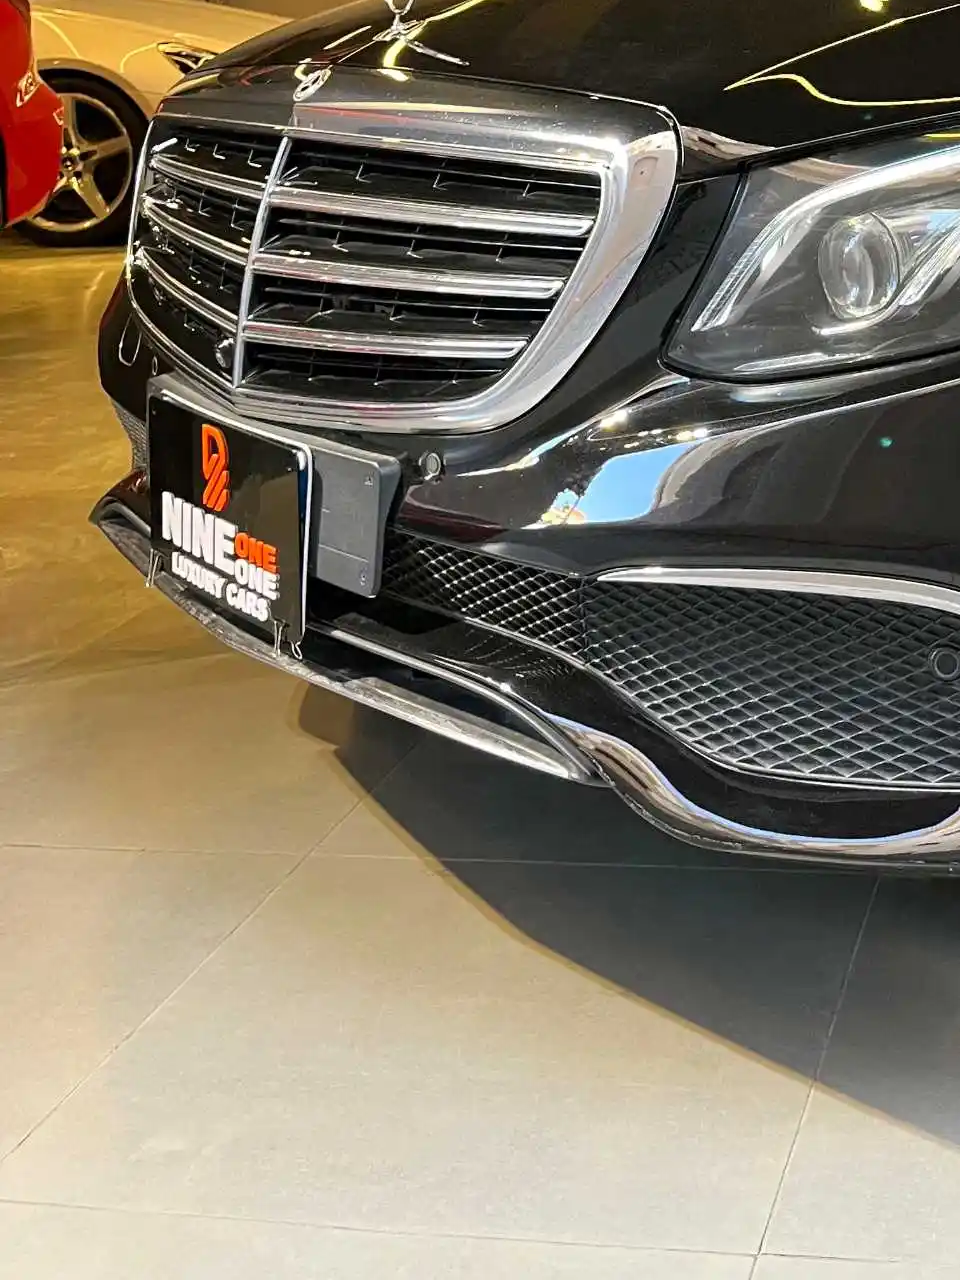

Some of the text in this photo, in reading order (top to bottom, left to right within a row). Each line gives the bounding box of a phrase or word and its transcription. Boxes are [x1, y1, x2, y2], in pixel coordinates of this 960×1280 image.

[161, 490, 240, 576] NINE
[235, 532, 279, 573] ONE
[172, 551, 271, 622] LUXURY CARS
[234, 558, 281, 601] ONE
